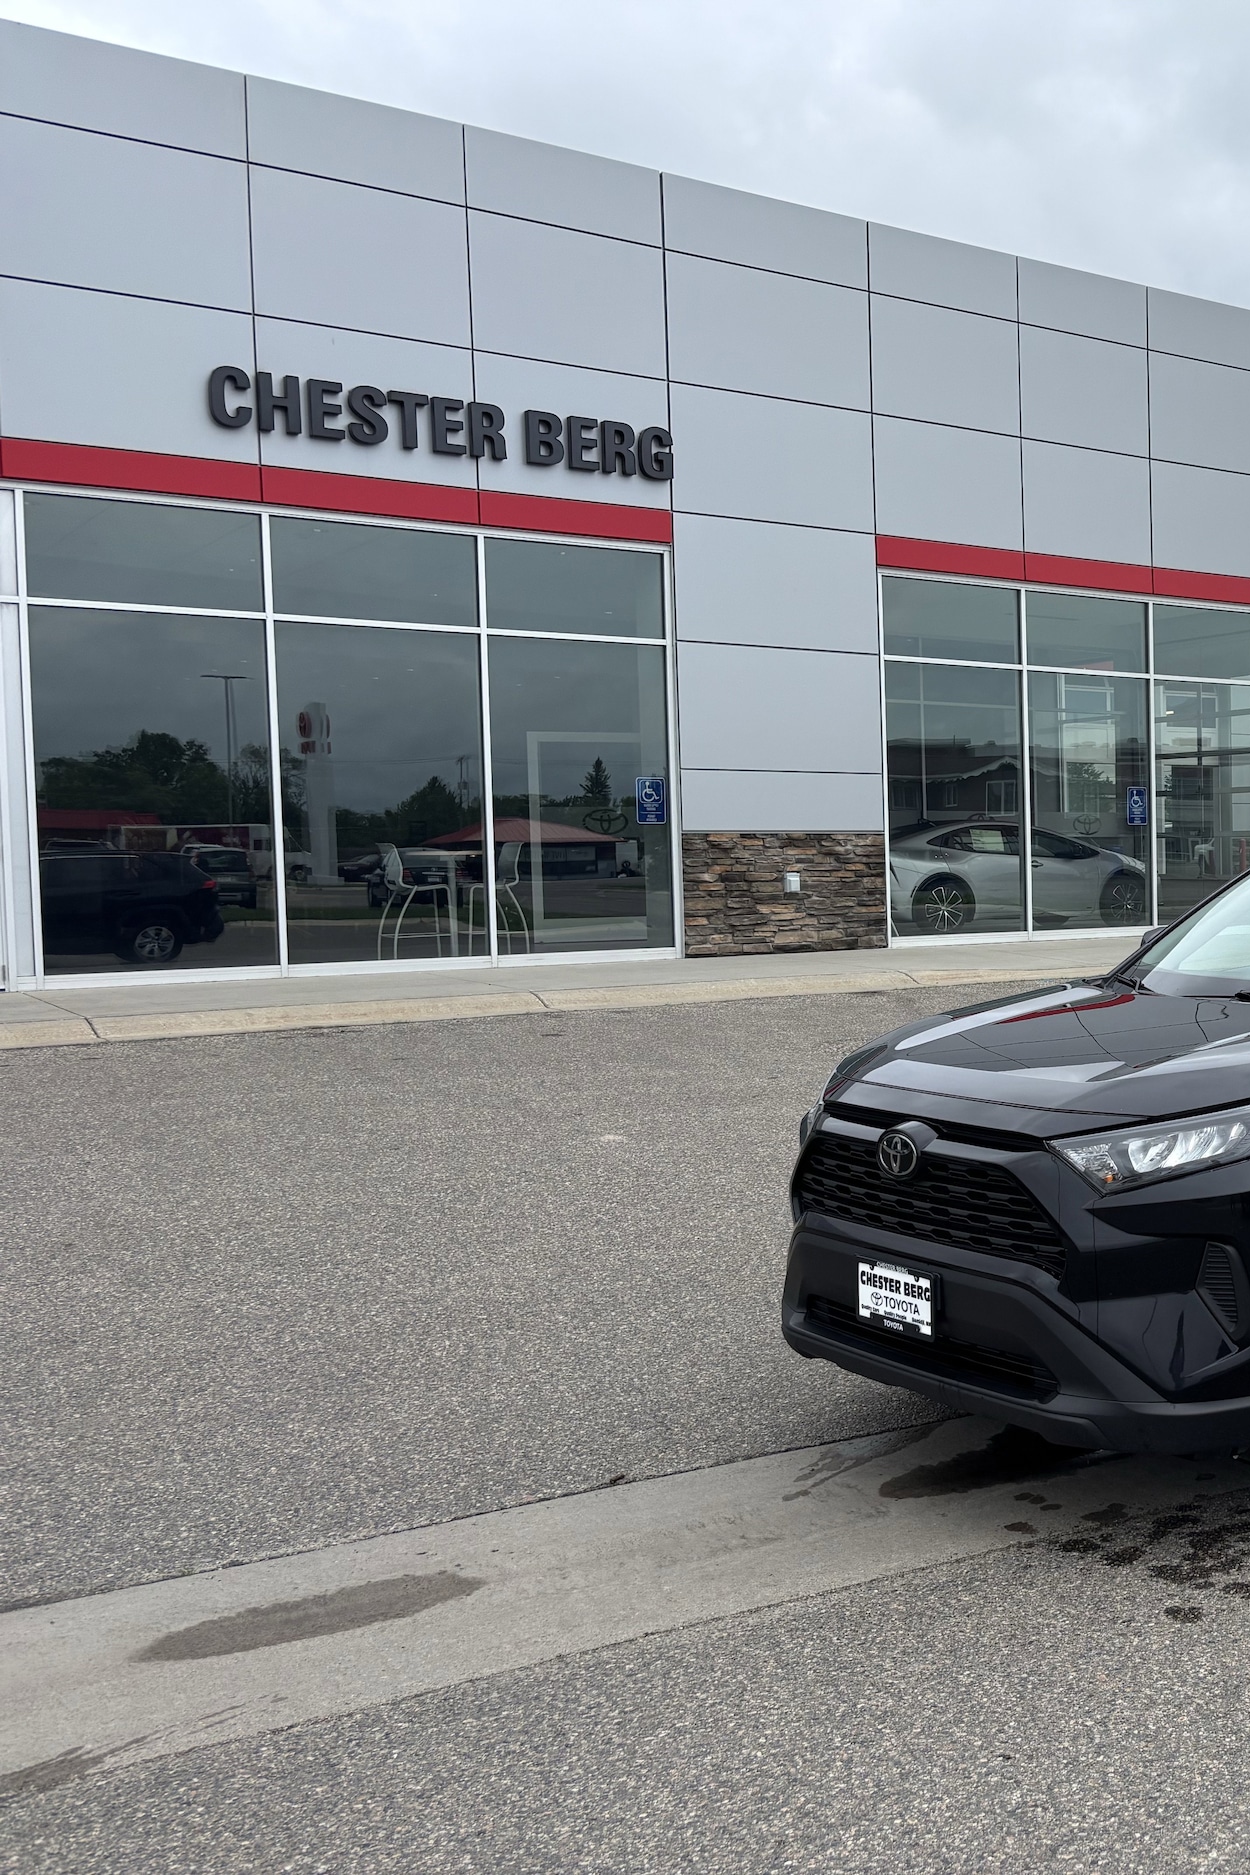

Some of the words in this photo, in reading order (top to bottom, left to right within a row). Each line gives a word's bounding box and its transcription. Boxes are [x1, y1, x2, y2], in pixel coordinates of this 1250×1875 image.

[207, 365, 508, 461] CHESTER
[523, 409, 675, 481] BERG
[860, 1270, 902, 1295] CHESTER
[903, 1282, 932, 1303] BERG
[883, 1295, 921, 1316] TOYOTA
[883, 1319, 903, 1331] TOYOTA
